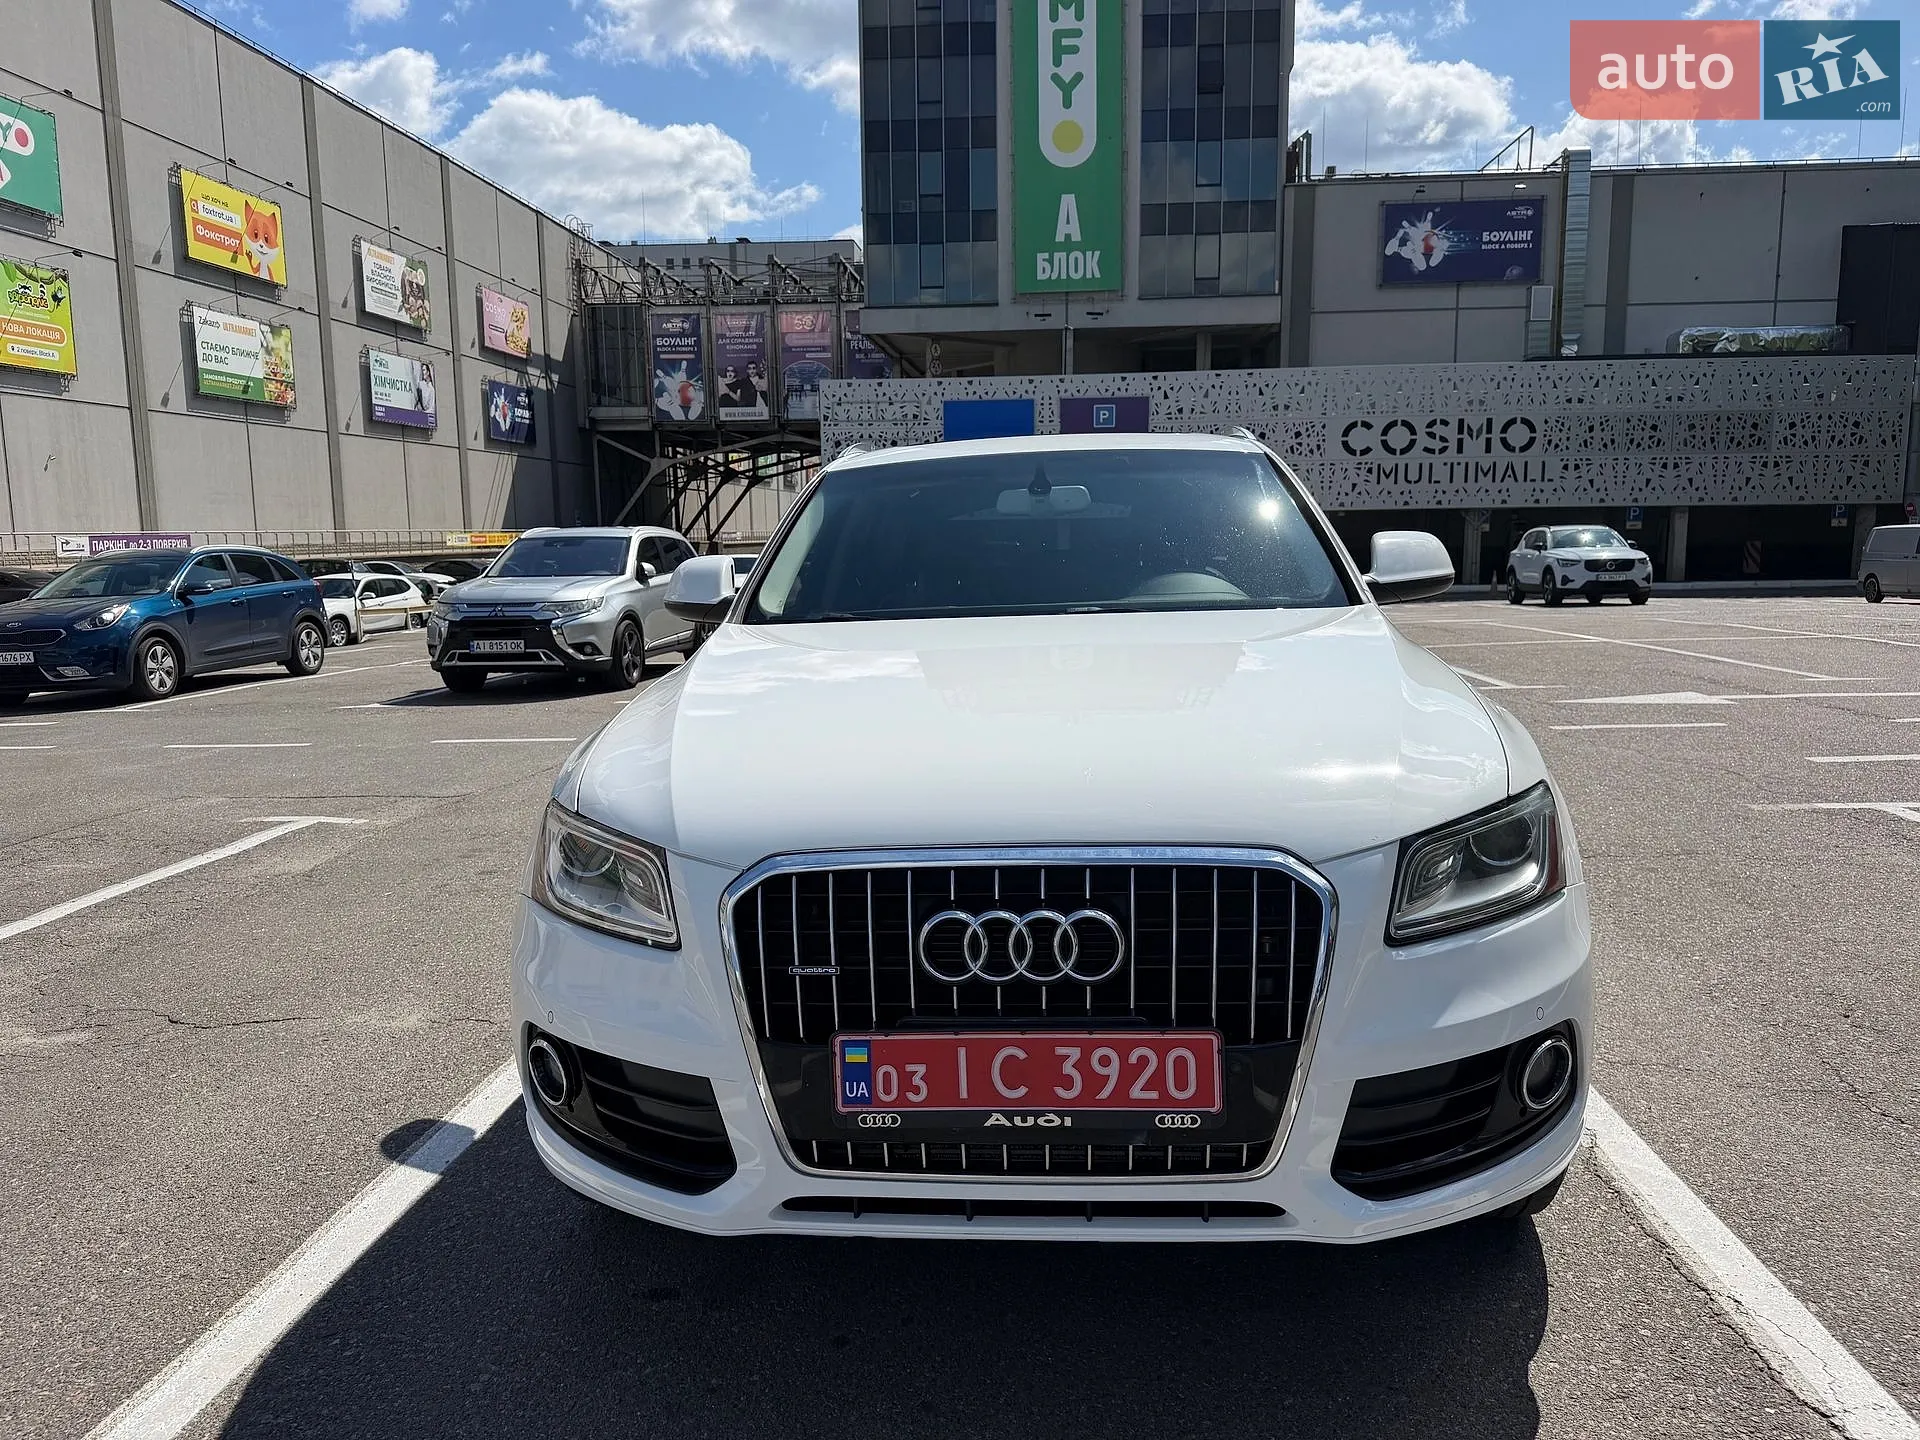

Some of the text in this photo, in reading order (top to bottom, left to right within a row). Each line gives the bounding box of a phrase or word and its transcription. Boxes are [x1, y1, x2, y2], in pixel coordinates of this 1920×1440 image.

[196, 224, 240, 248] Фокстрот
[1482, 230, 1533, 242] БОУЛІНГ
[1036, 251, 1101, 280] БЛОК
[26, 326, 60, 340] ЛОКАЦІЯ
[656, 337, 697, 346] БОУЛІНГ
[202, 352, 228, 366] ДО ВАС
[374, 374, 413, 394] ХІМЧИСТКА
[1100, 410, 1109, 423] P
[1341, 416, 1537, 457] COSMO
[1376, 460, 1554, 485] MULTIMALL
[1630, 507, 1640, 520] P
[92, 540, 128, 552] ПАРКІНГ
[488, 641, 508, 650] 8151
[510, 641, 522, 650] OK
[845, 1082, 869, 1098] UA
[876, 1064, 928, 1102] 03
[1053, 1046, 1197, 1100] 3920
[984, 1113, 1072, 1128] Audi
